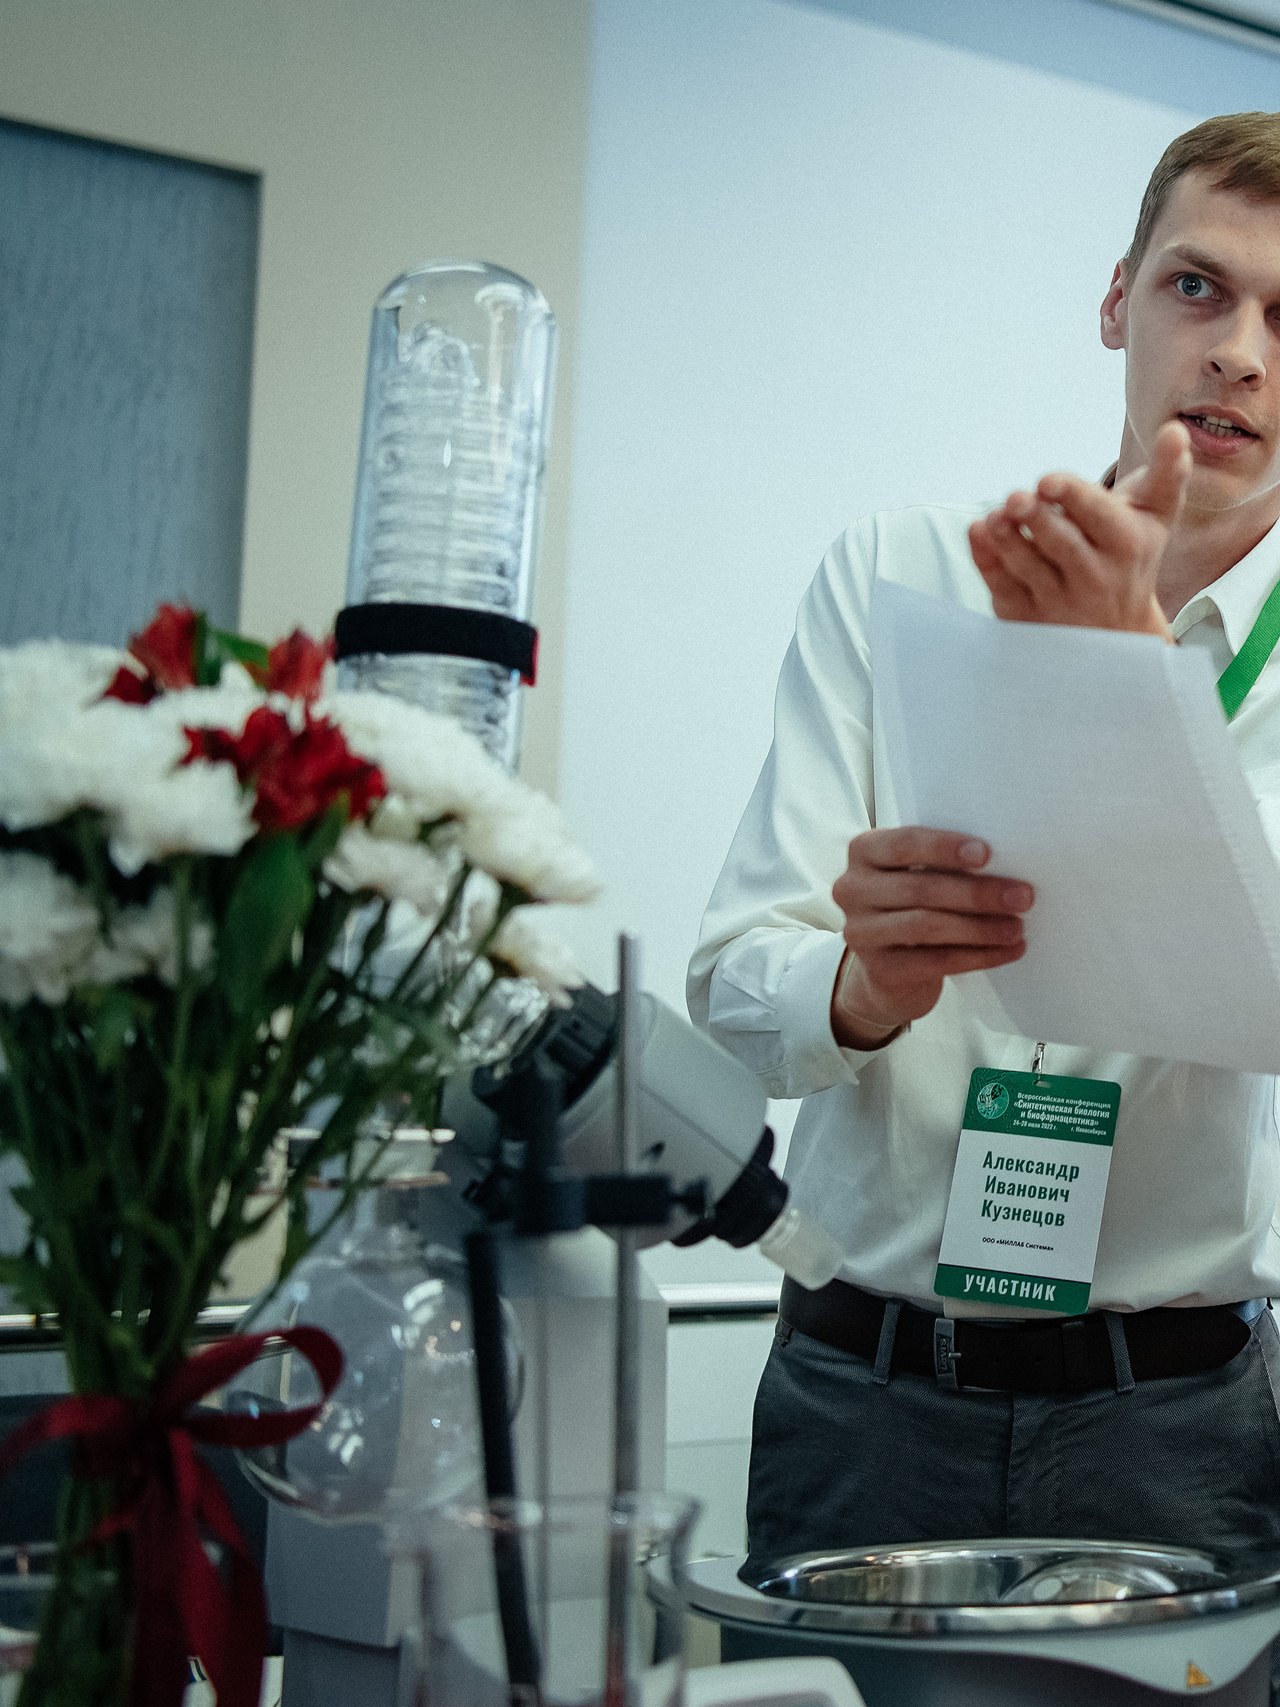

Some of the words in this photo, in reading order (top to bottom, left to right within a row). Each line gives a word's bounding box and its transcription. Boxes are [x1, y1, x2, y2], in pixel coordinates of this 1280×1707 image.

[1013, 1099, 1073, 1115] «Синтетическая
[1074, 1105, 1110, 1119] биология
[1017, 1092, 1065, 1104] Всероссийская
[1065, 1098, 1112, 1110] конференция
[1026, 1109, 1100, 1127] биофармацевтика»
[982, 1150, 1080, 1183] Александр
[984, 1175, 1070, 1203] Иванович
[981, 1199, 1065, 1227] Кузнецов
[982, 1236, 996, 1244] ООО
[963, 1273, 1057, 1302] УЧАСТНИК
